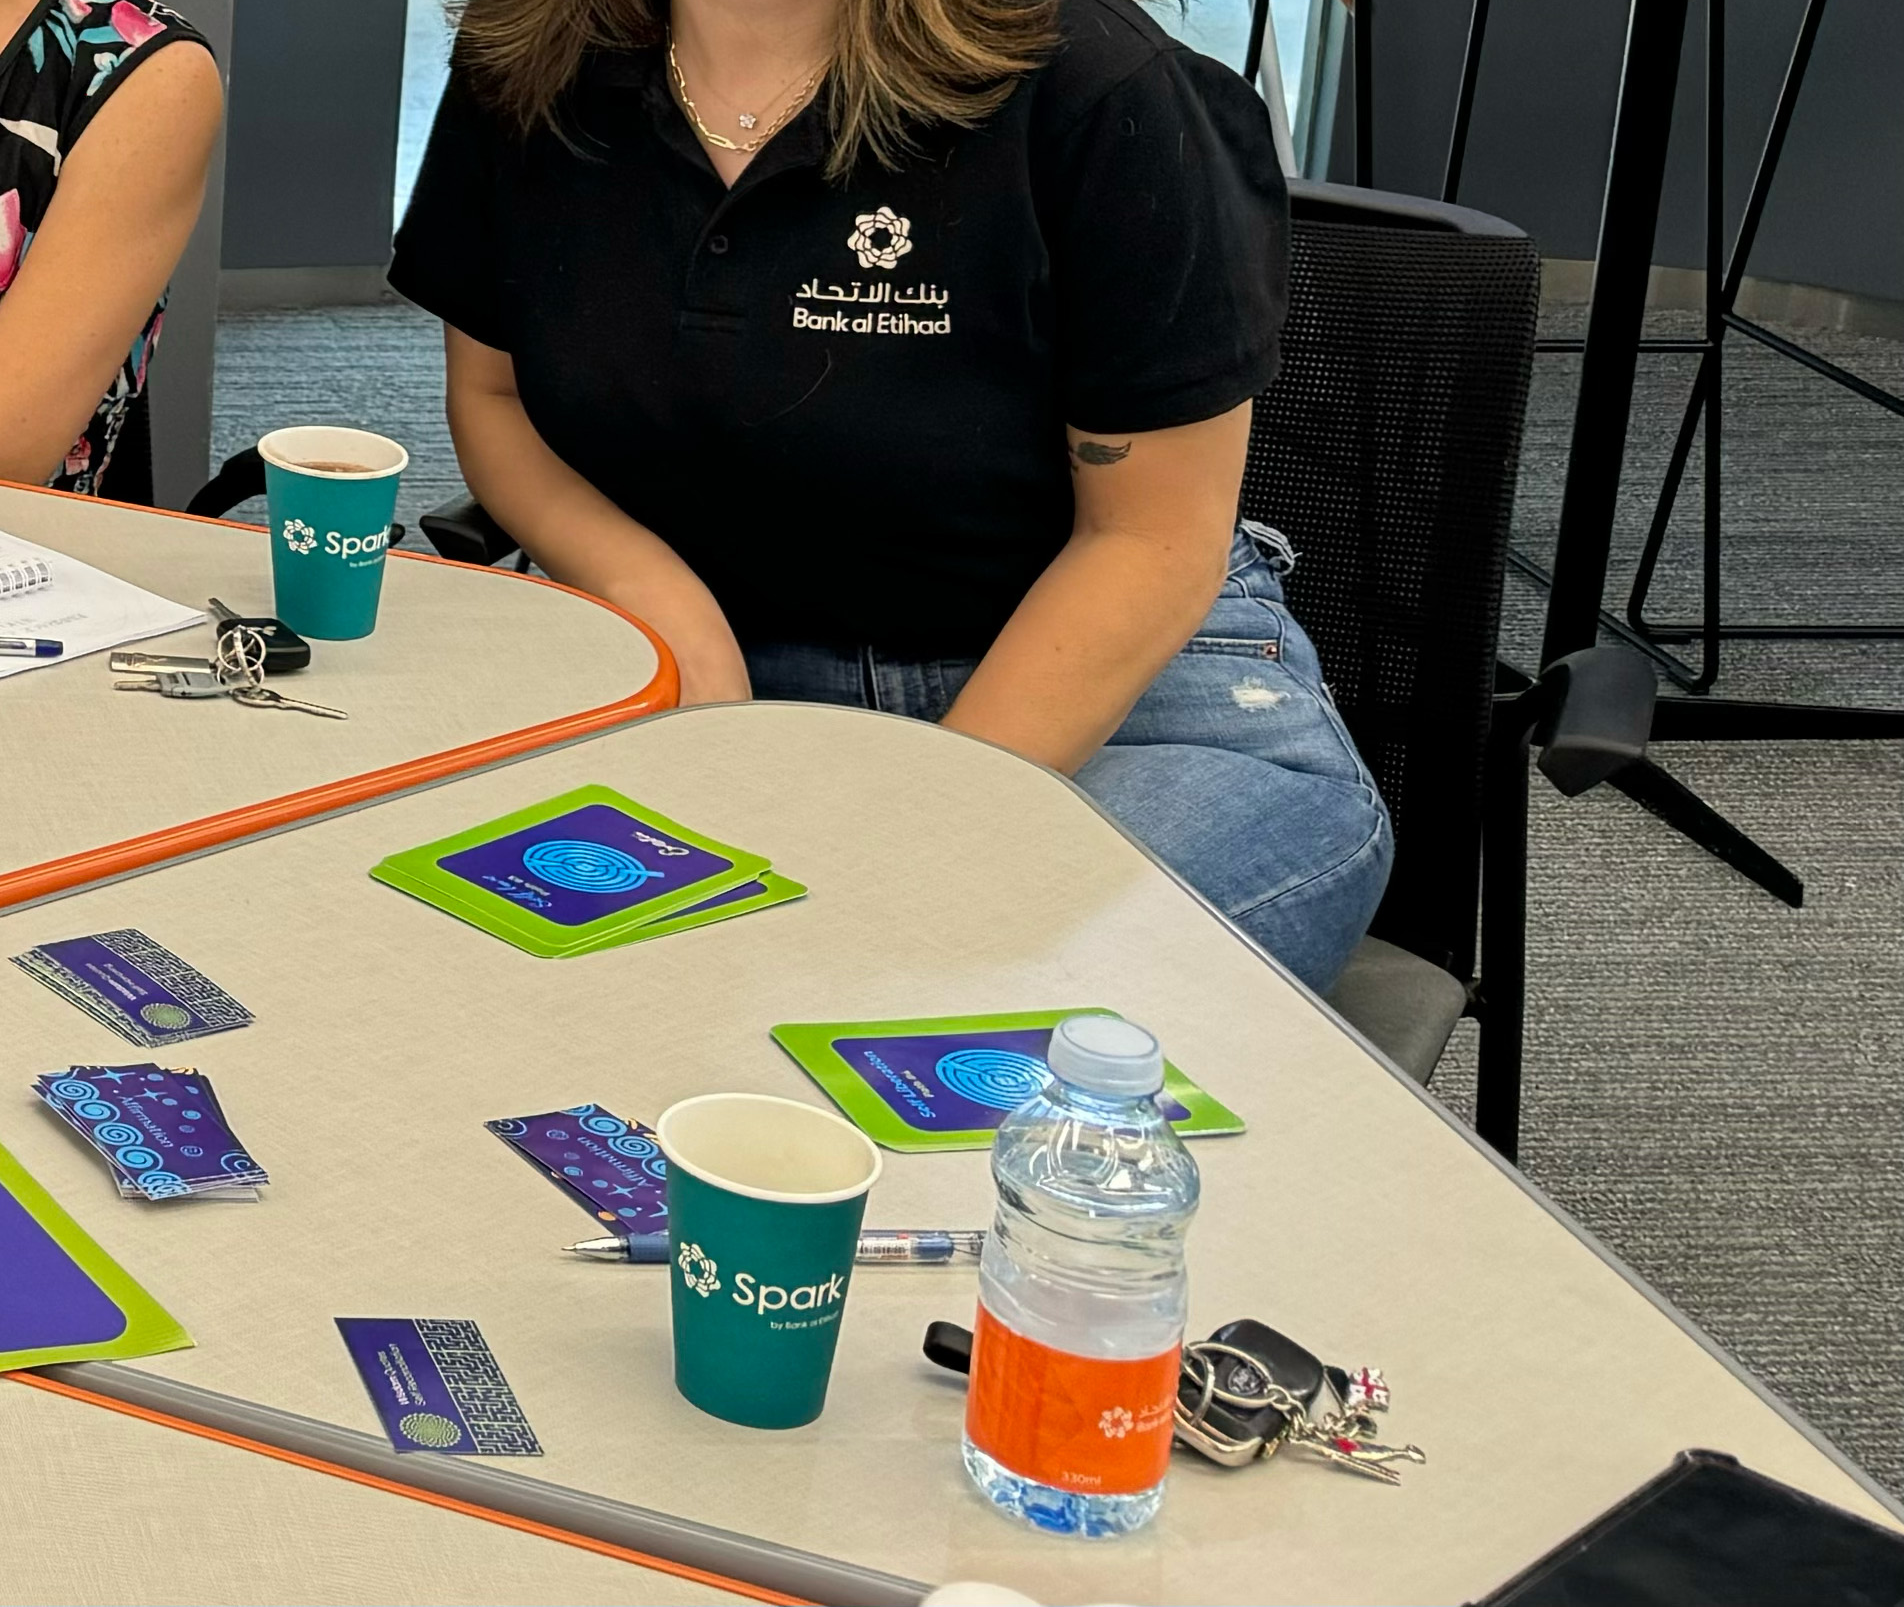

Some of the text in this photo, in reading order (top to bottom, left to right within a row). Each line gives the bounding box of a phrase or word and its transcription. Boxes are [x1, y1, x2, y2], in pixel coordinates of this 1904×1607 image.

[795, 278, 949, 309] بنك الاتحاد
[793, 307, 951, 335] Bank al Etihad
[325, 524, 392, 559] Spark
[863, 1051, 936, 1117] Self Liberation
[117, 1095, 174, 1148] Affirmation
[577, 1137, 655, 1187] Affirmation
[732, 1272, 845, 1315] Spark
[785, 1319, 807, 1330] Bank
